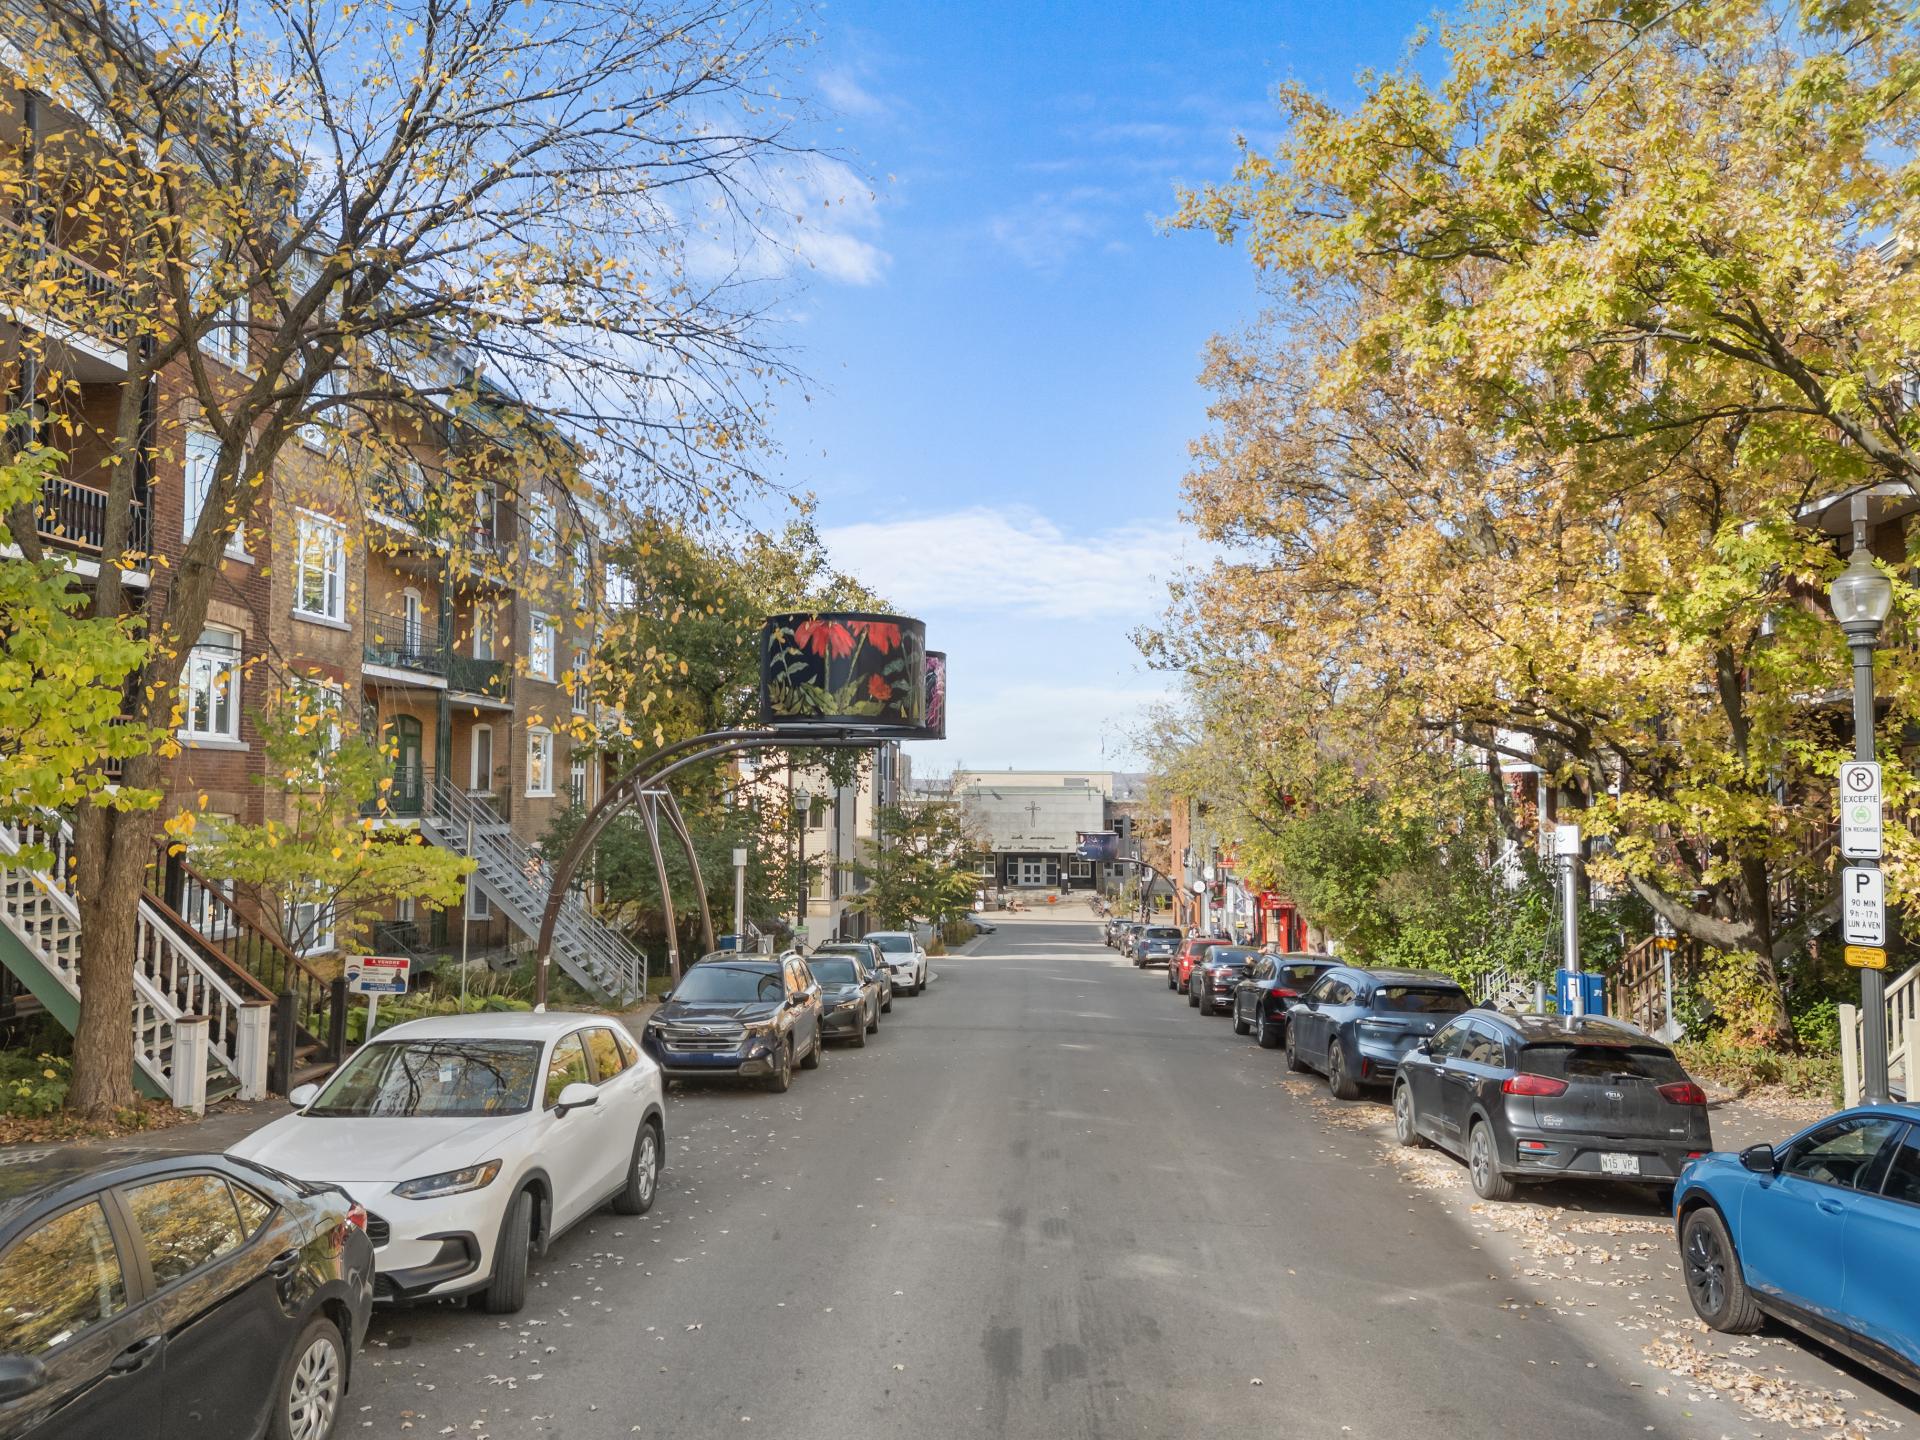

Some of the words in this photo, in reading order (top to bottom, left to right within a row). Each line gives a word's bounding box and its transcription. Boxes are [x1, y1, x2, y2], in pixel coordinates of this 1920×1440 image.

[1844, 794, 1878, 802] EXCEPTÉ
[1856, 873, 1871, 893] P
[1851, 898, 1861, 907] 90
[1863, 899, 1876, 907] MIN
[1848, 920, 1860, 928] LUN
[1868, 921, 1881, 930] VEN
